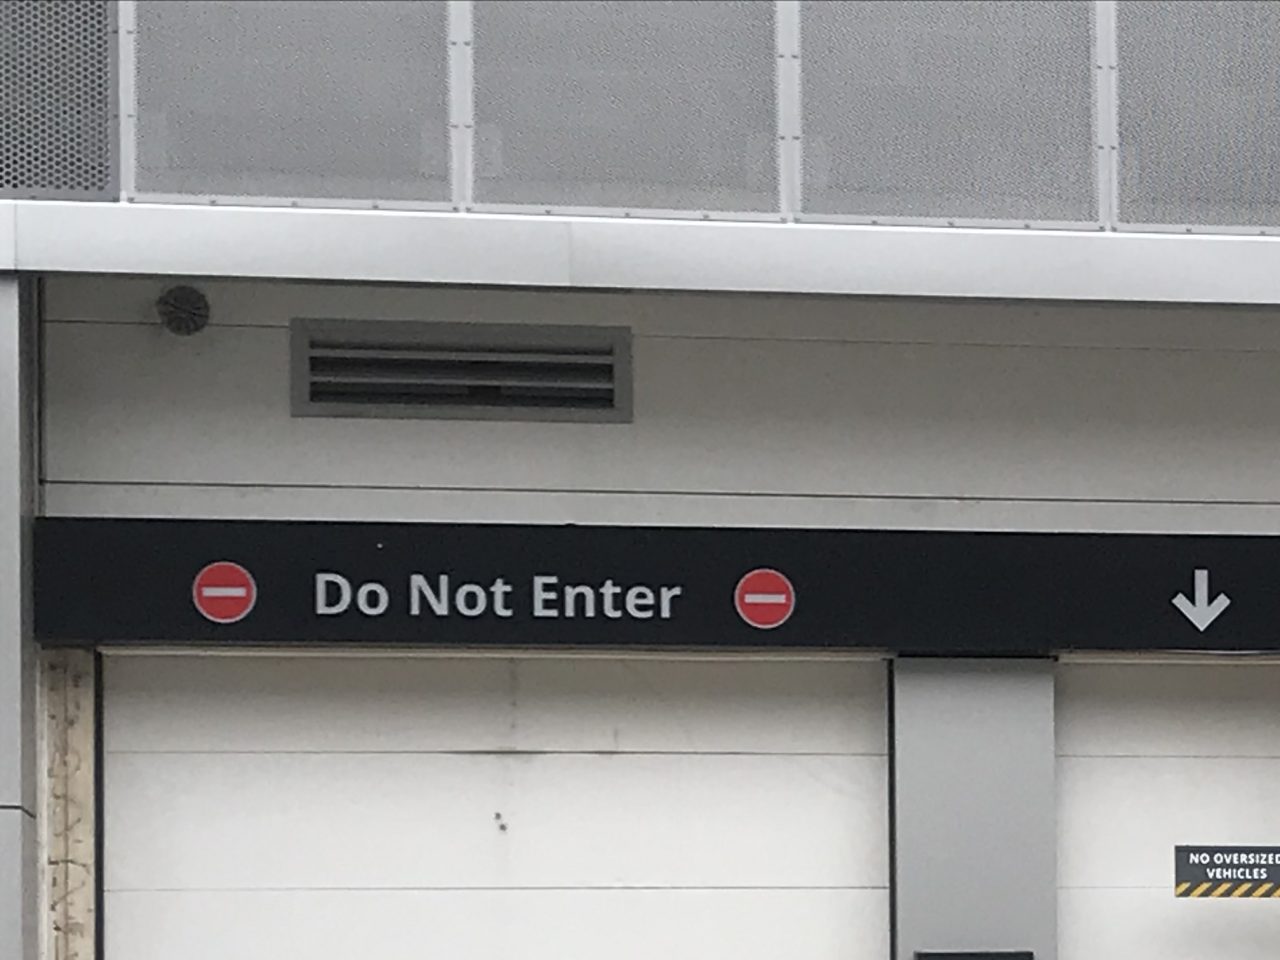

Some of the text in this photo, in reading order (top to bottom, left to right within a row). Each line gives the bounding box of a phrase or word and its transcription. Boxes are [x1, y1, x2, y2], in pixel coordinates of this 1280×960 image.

[315, 573, 682, 618] Do Not Enter
[1189, 853, 1210, 865] NO
[1206, 868, 1268, 879] VEHICLES
